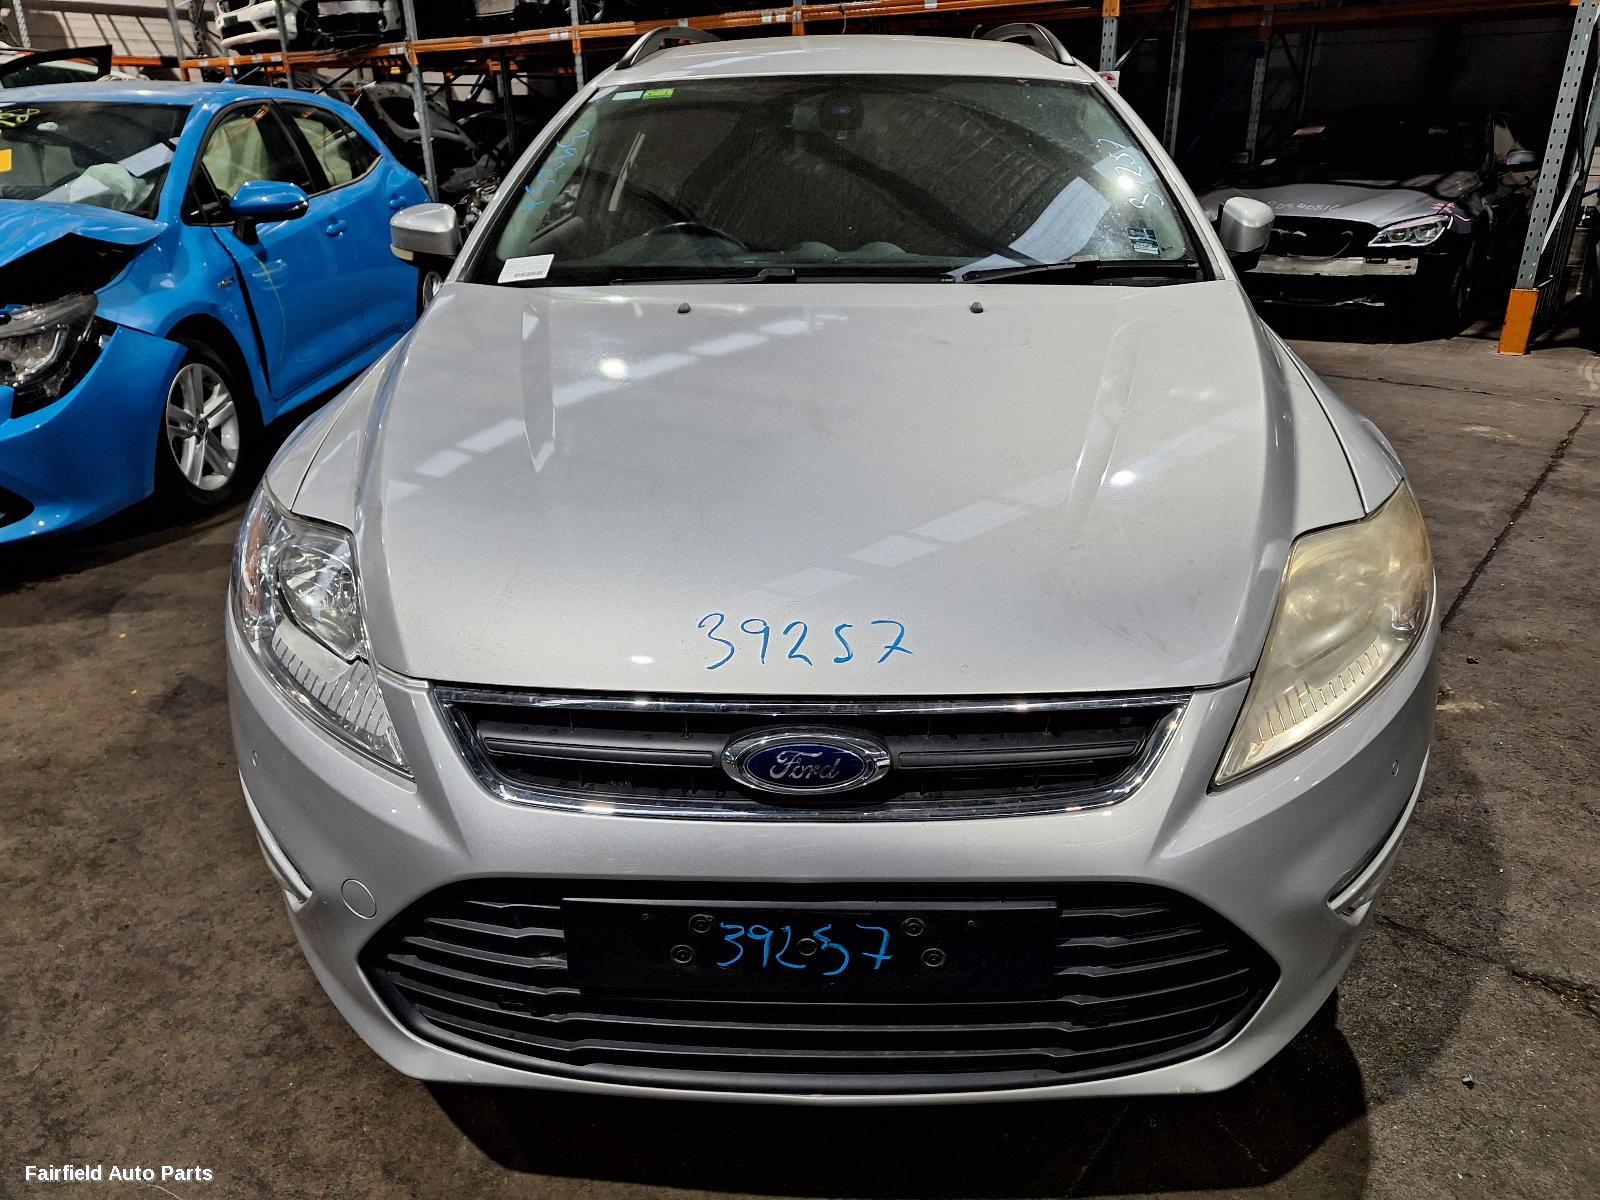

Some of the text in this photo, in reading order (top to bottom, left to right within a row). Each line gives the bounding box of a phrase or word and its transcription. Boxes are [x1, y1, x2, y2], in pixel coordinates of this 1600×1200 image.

[697, 612, 913, 670] 39257
[769, 750, 842, 780] Ford
[716, 922, 893, 977] 39257
